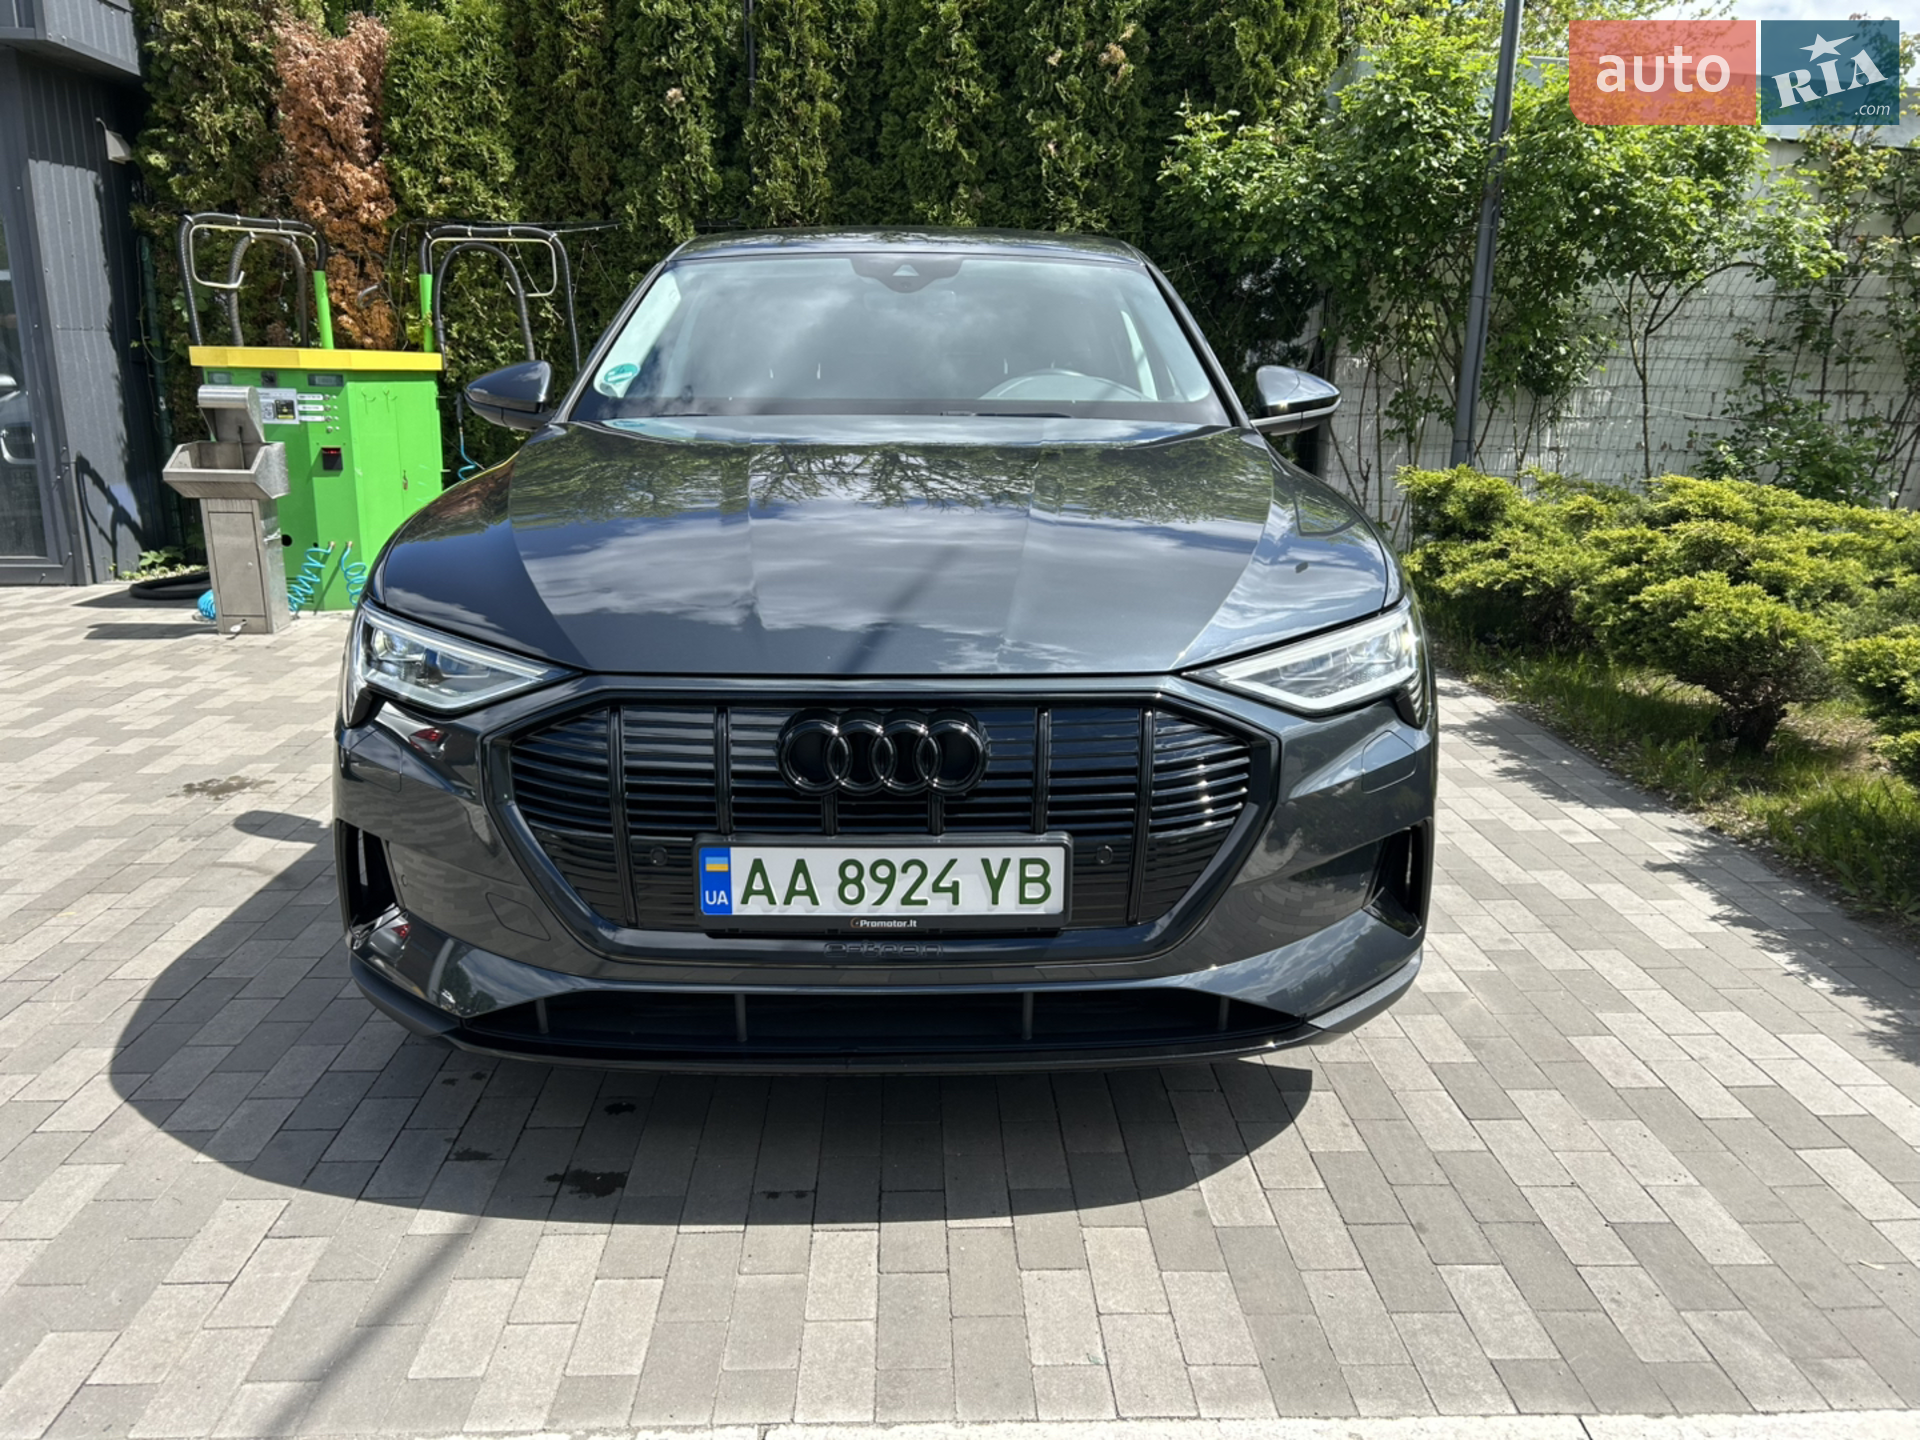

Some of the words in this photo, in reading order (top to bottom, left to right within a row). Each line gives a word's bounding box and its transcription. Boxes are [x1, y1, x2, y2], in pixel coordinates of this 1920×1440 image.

[705, 890, 729, 905] UA
[740, 858, 820, 905] AA
[837, 858, 960, 906] 8924
[981, 857, 1052, 905] YB
